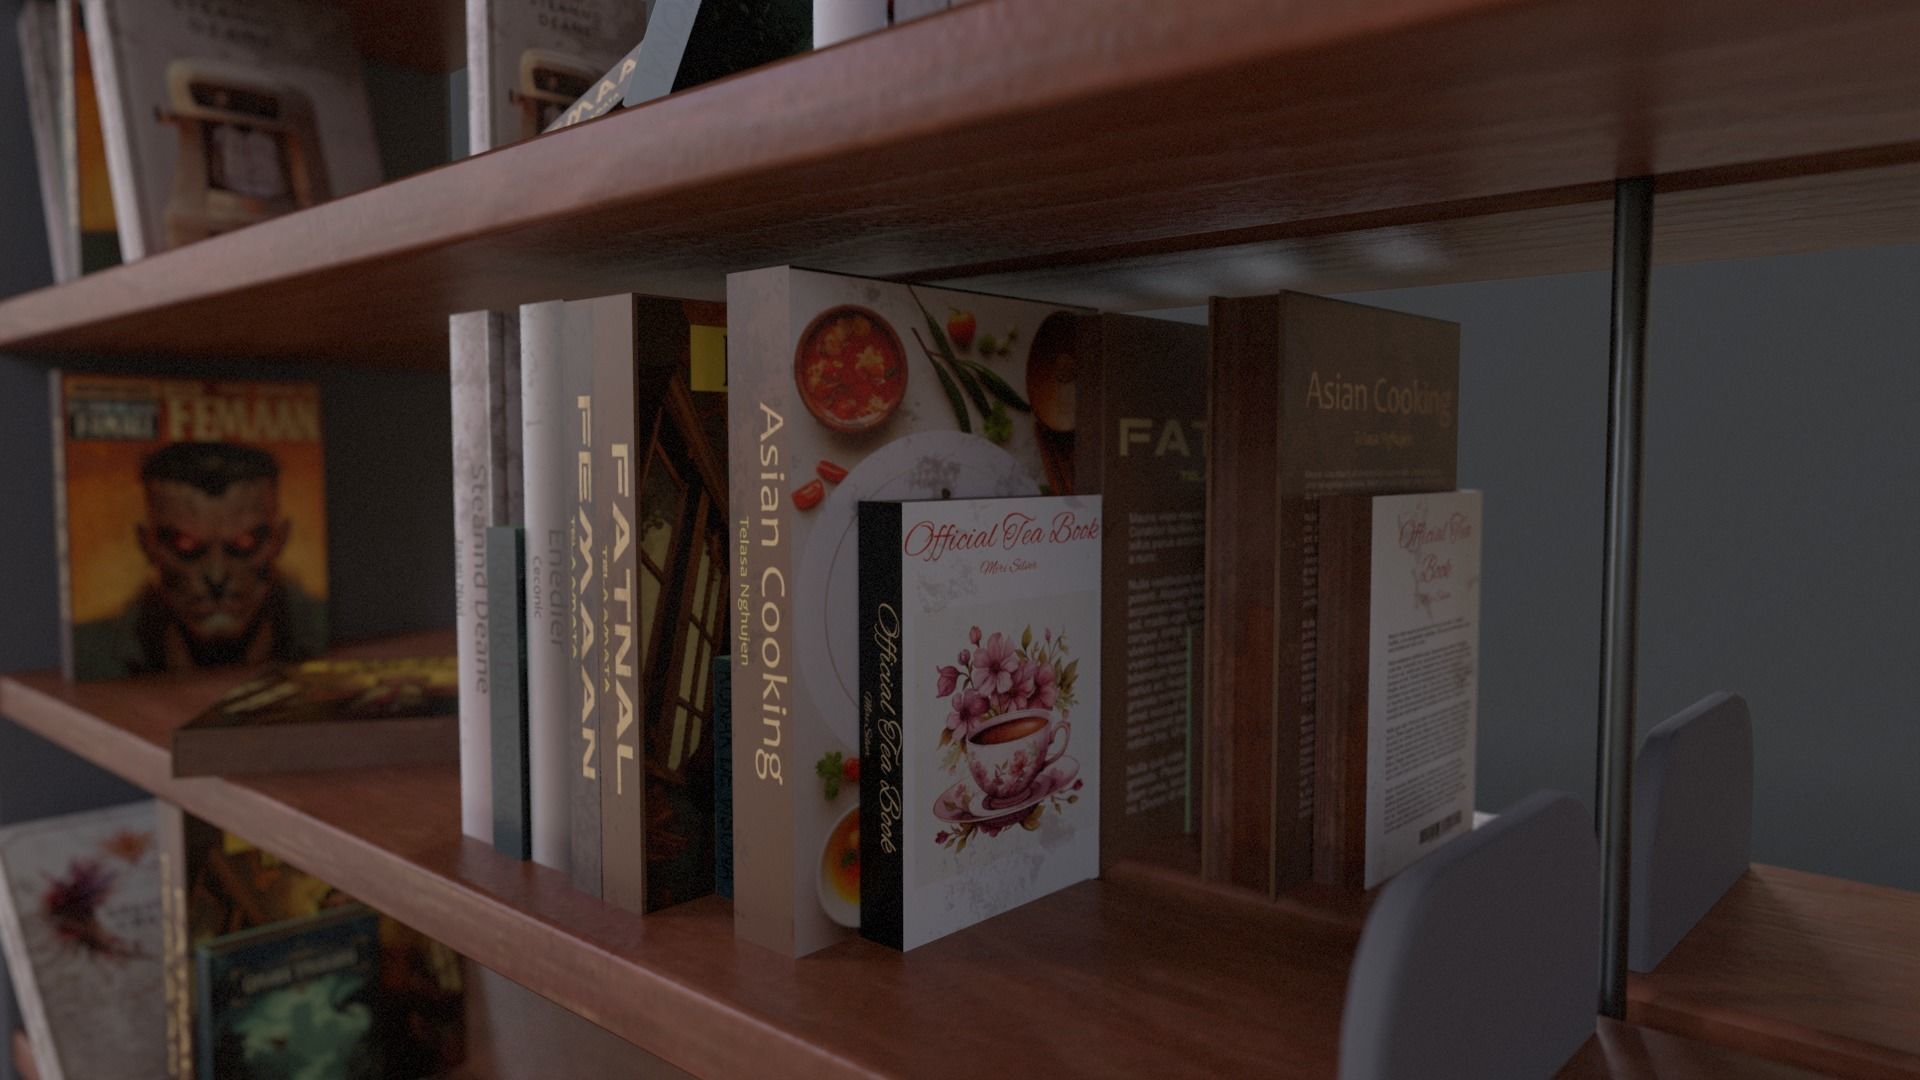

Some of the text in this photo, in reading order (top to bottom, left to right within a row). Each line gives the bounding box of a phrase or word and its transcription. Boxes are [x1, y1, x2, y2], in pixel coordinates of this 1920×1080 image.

[1305, 370, 1453, 428] Asian Cooking
[470, 463, 490, 695] Steannd Deane
[548, 529, 568, 654] Enedier
[577, 395, 597, 781] FEMAAN
[611, 443, 634, 795] FATNAL
[737, 516, 751, 667] Telasa Nghujen
[755, 401, 788, 785] Asian Cooking
[904, 520, 998, 562] Official
[1002, 511, 1045, 551] Tea
[1048, 511, 1101, 544] Book
[874, 602, 903, 854] Official Tea Book
